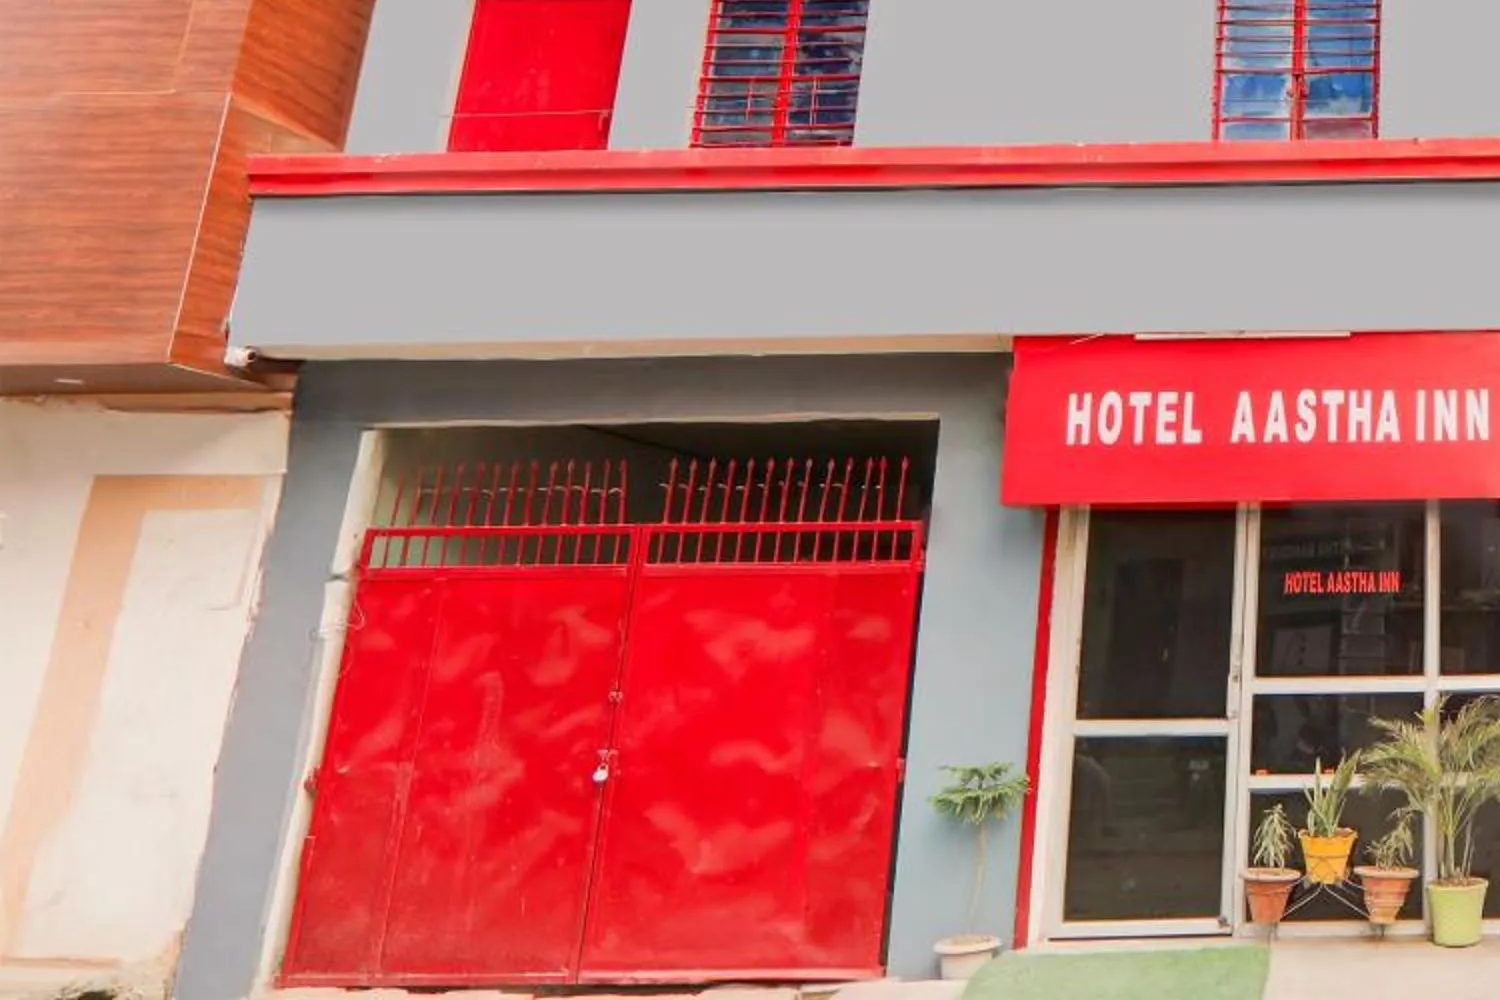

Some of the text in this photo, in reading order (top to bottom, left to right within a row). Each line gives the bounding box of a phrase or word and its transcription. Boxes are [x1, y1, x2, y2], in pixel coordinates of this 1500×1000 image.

[1066, 388, 1491, 446] HOTEL AASTHA INN
[1284, 571, 1400, 594] HOTEL AASTHA INN
